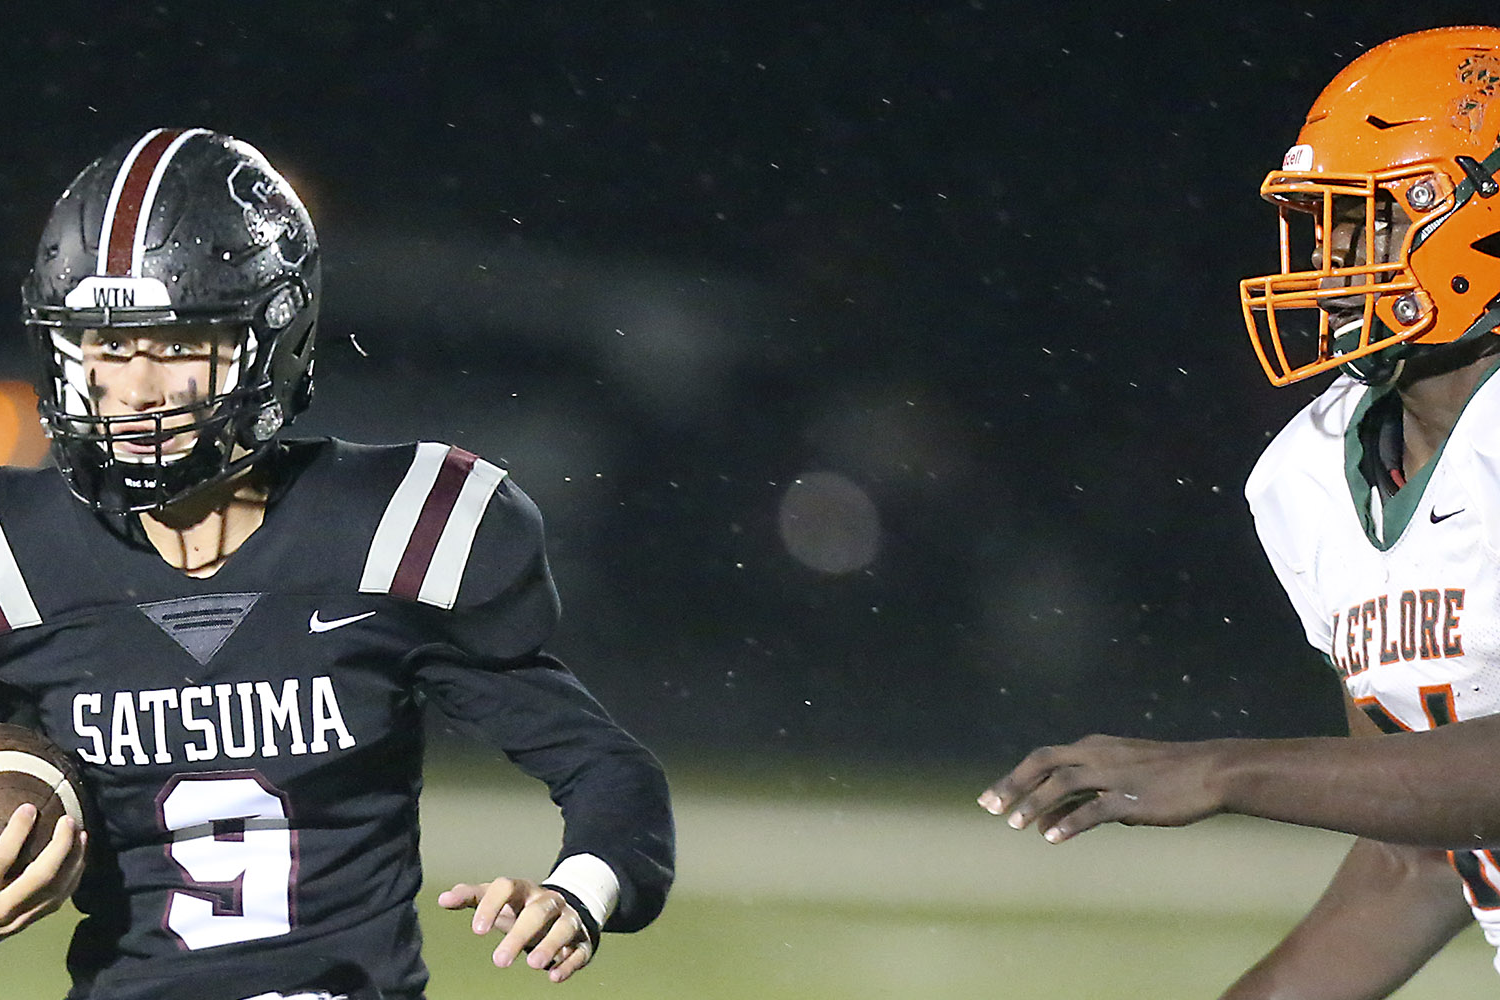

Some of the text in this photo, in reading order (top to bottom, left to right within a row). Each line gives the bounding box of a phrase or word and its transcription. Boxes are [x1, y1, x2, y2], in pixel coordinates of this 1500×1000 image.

[1332, 588, 1466, 681] LEFLORE
[72, 676, 357, 766] SATSUMA
[155, 768, 300, 952] 9
